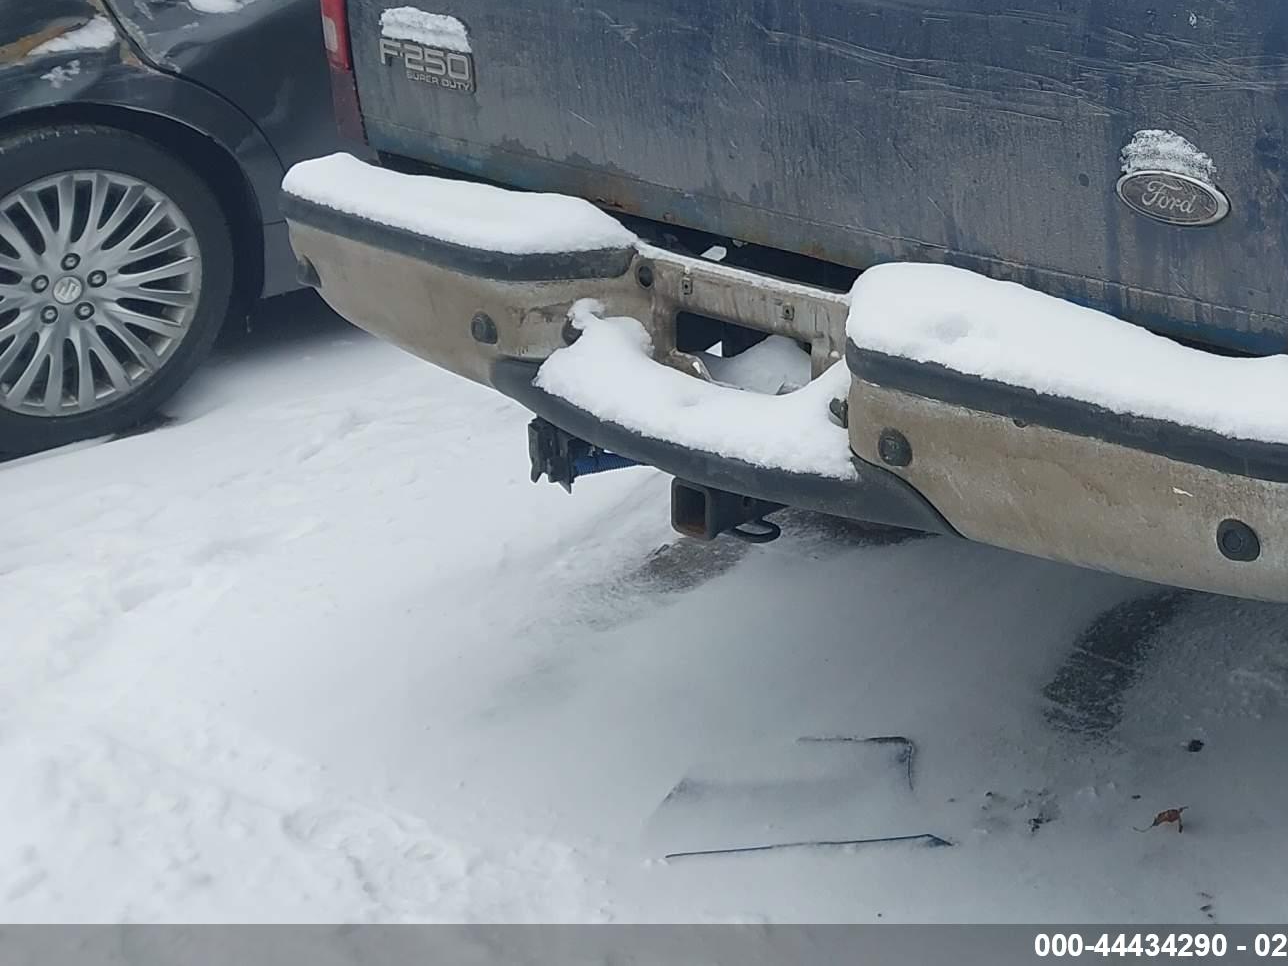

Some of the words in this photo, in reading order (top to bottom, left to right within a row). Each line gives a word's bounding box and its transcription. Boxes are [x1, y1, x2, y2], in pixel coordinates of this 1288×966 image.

[406, 70, 439, 86] SUPER
[441, 78, 471, 92] DUTY
[1141, 180, 1197, 214] Ford
